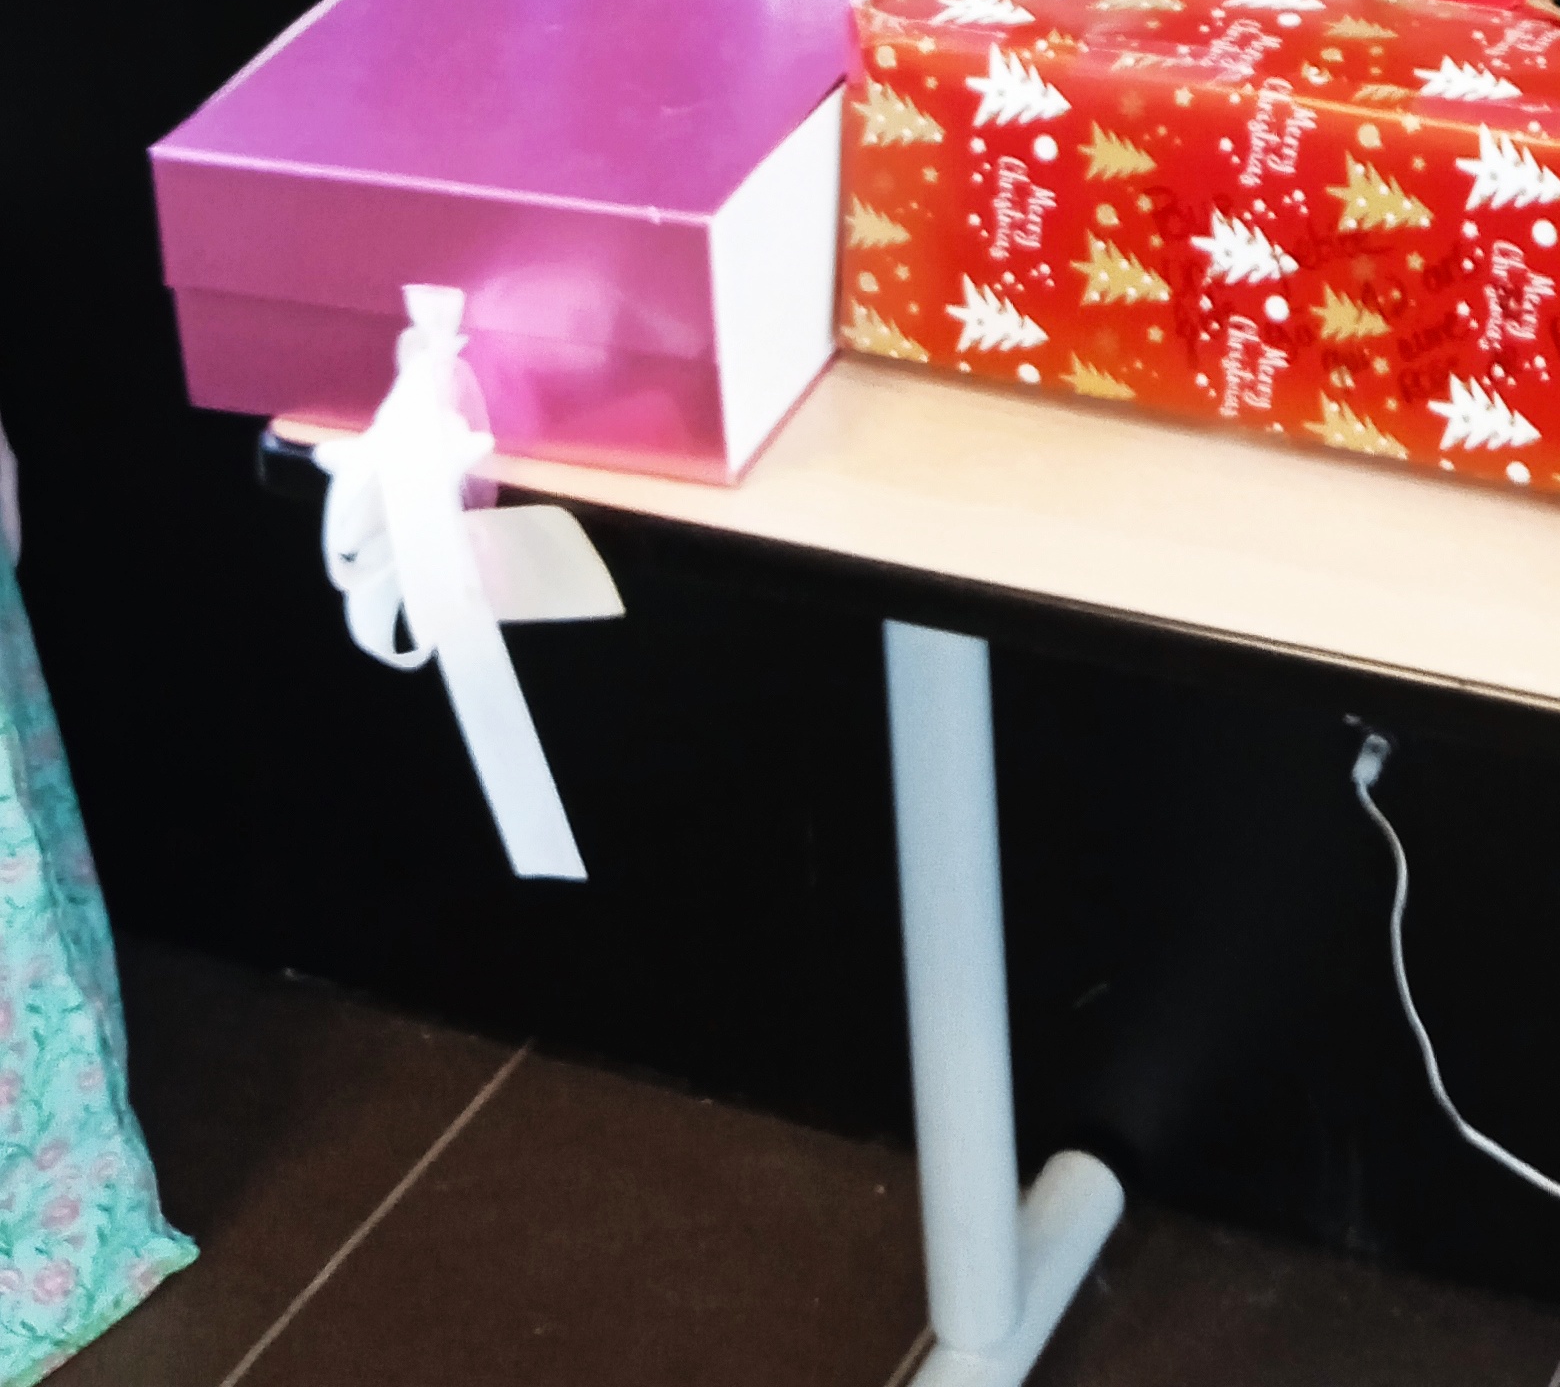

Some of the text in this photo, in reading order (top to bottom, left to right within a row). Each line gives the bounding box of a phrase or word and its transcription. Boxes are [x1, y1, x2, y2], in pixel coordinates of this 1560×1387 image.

[1238, 77, 1294, 187] Christmas
[1266, 105, 1318, 174] Merry
[988, 155, 1031, 261] Christmas
[1012, 183, 1057, 249] Merry
[1505, 269, 1557, 341] Merry
[1218, 314, 1261, 418] Christmas
[1243, 343, 1290, 410] Merry
